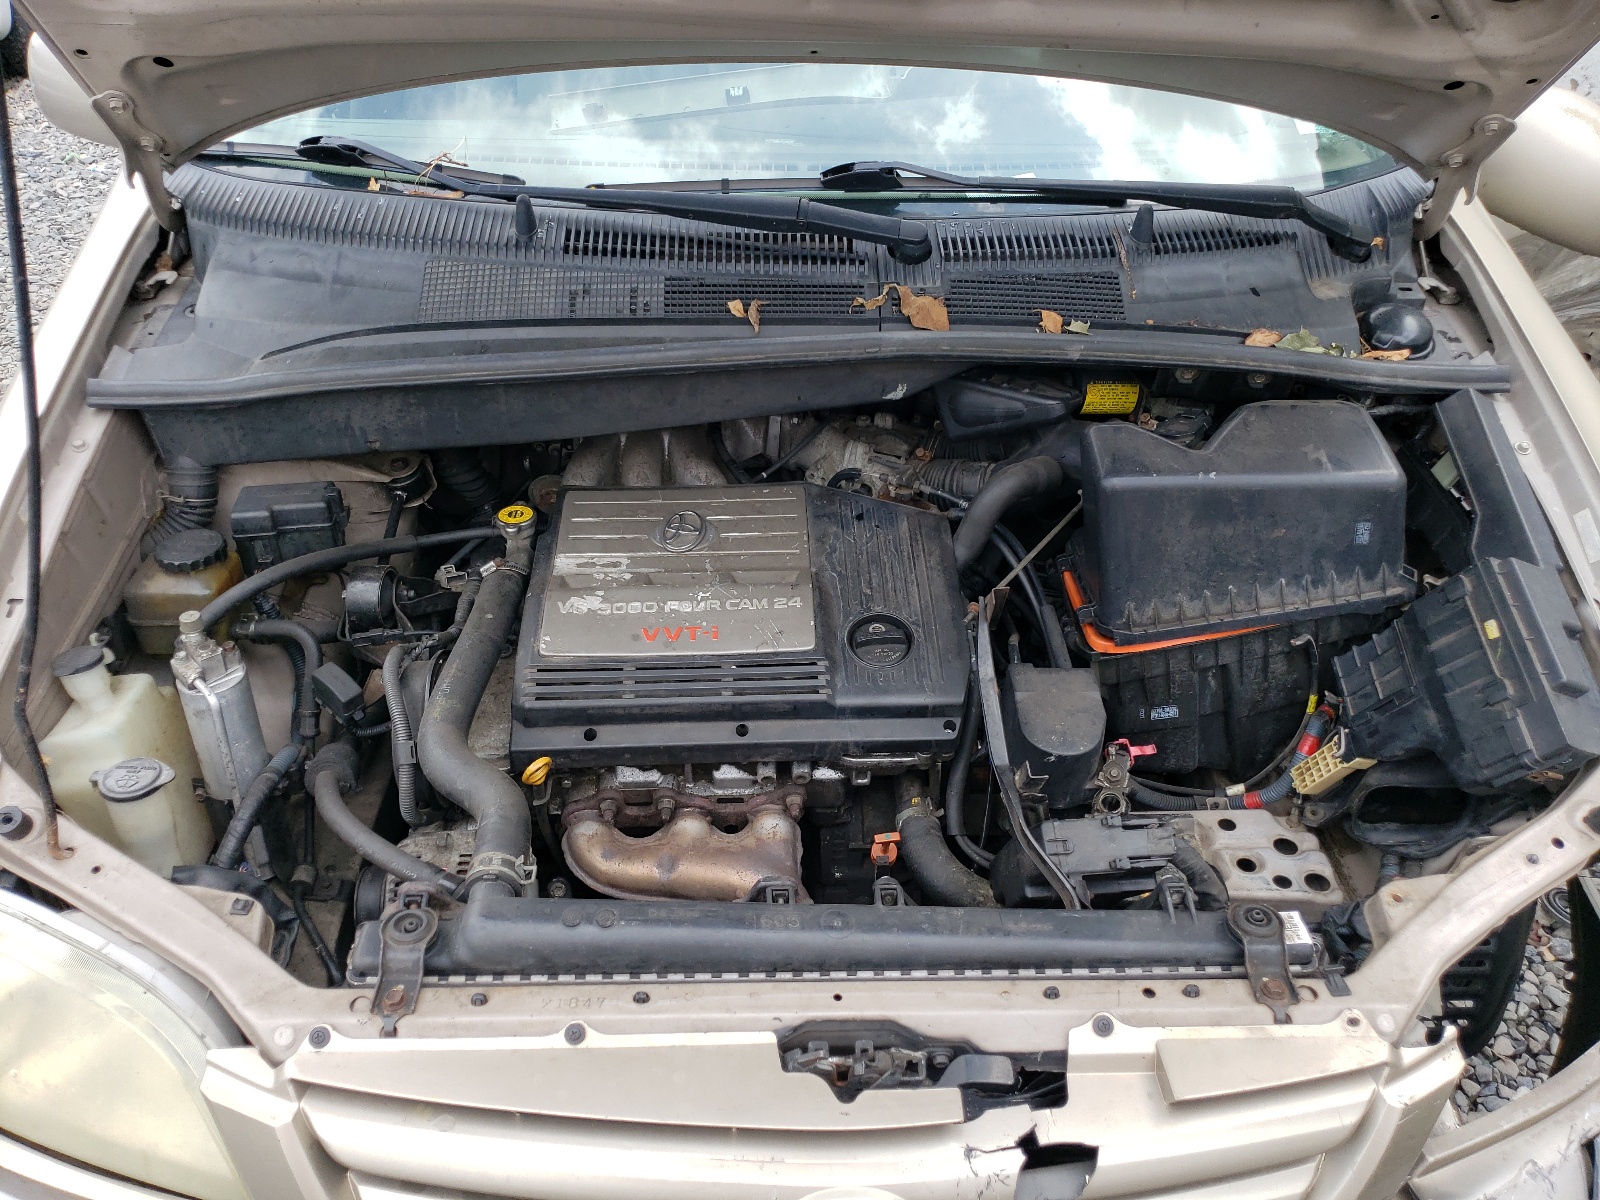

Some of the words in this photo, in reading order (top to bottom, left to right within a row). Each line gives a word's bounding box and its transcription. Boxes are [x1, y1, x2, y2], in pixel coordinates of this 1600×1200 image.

[664, 600, 722, 613] FOUR
[725, 598, 769, 610] CAM
[773, 597, 803, 609] 24
[641, 625, 719, 642] VVT-i
